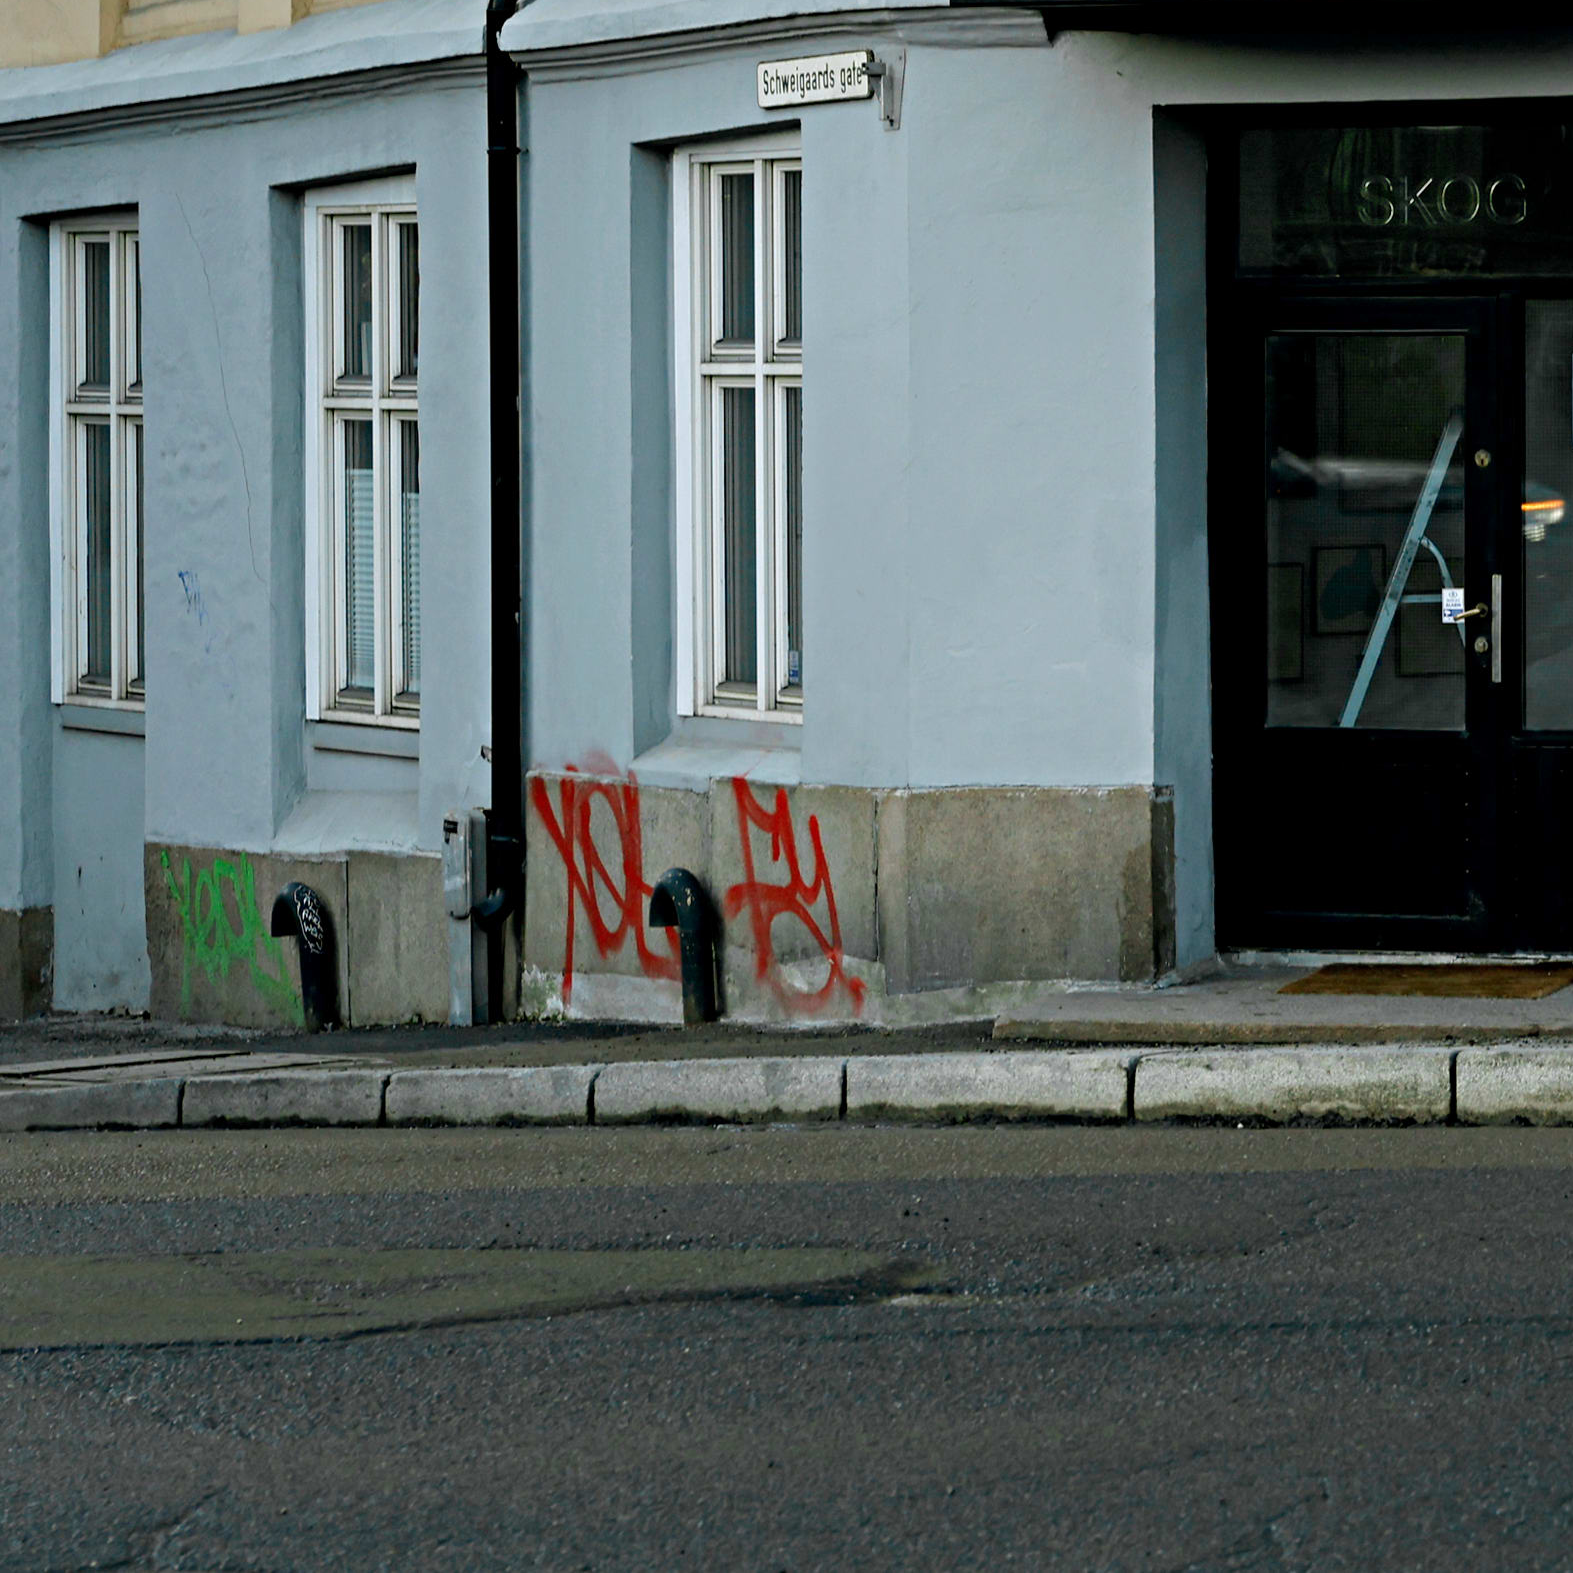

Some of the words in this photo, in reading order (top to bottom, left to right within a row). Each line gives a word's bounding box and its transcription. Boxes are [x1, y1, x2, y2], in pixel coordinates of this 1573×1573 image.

[763, 63, 835, 98] Schweigaards
[840, 61, 862, 94] gate
[1358, 174, 1527, 225] SKOG
